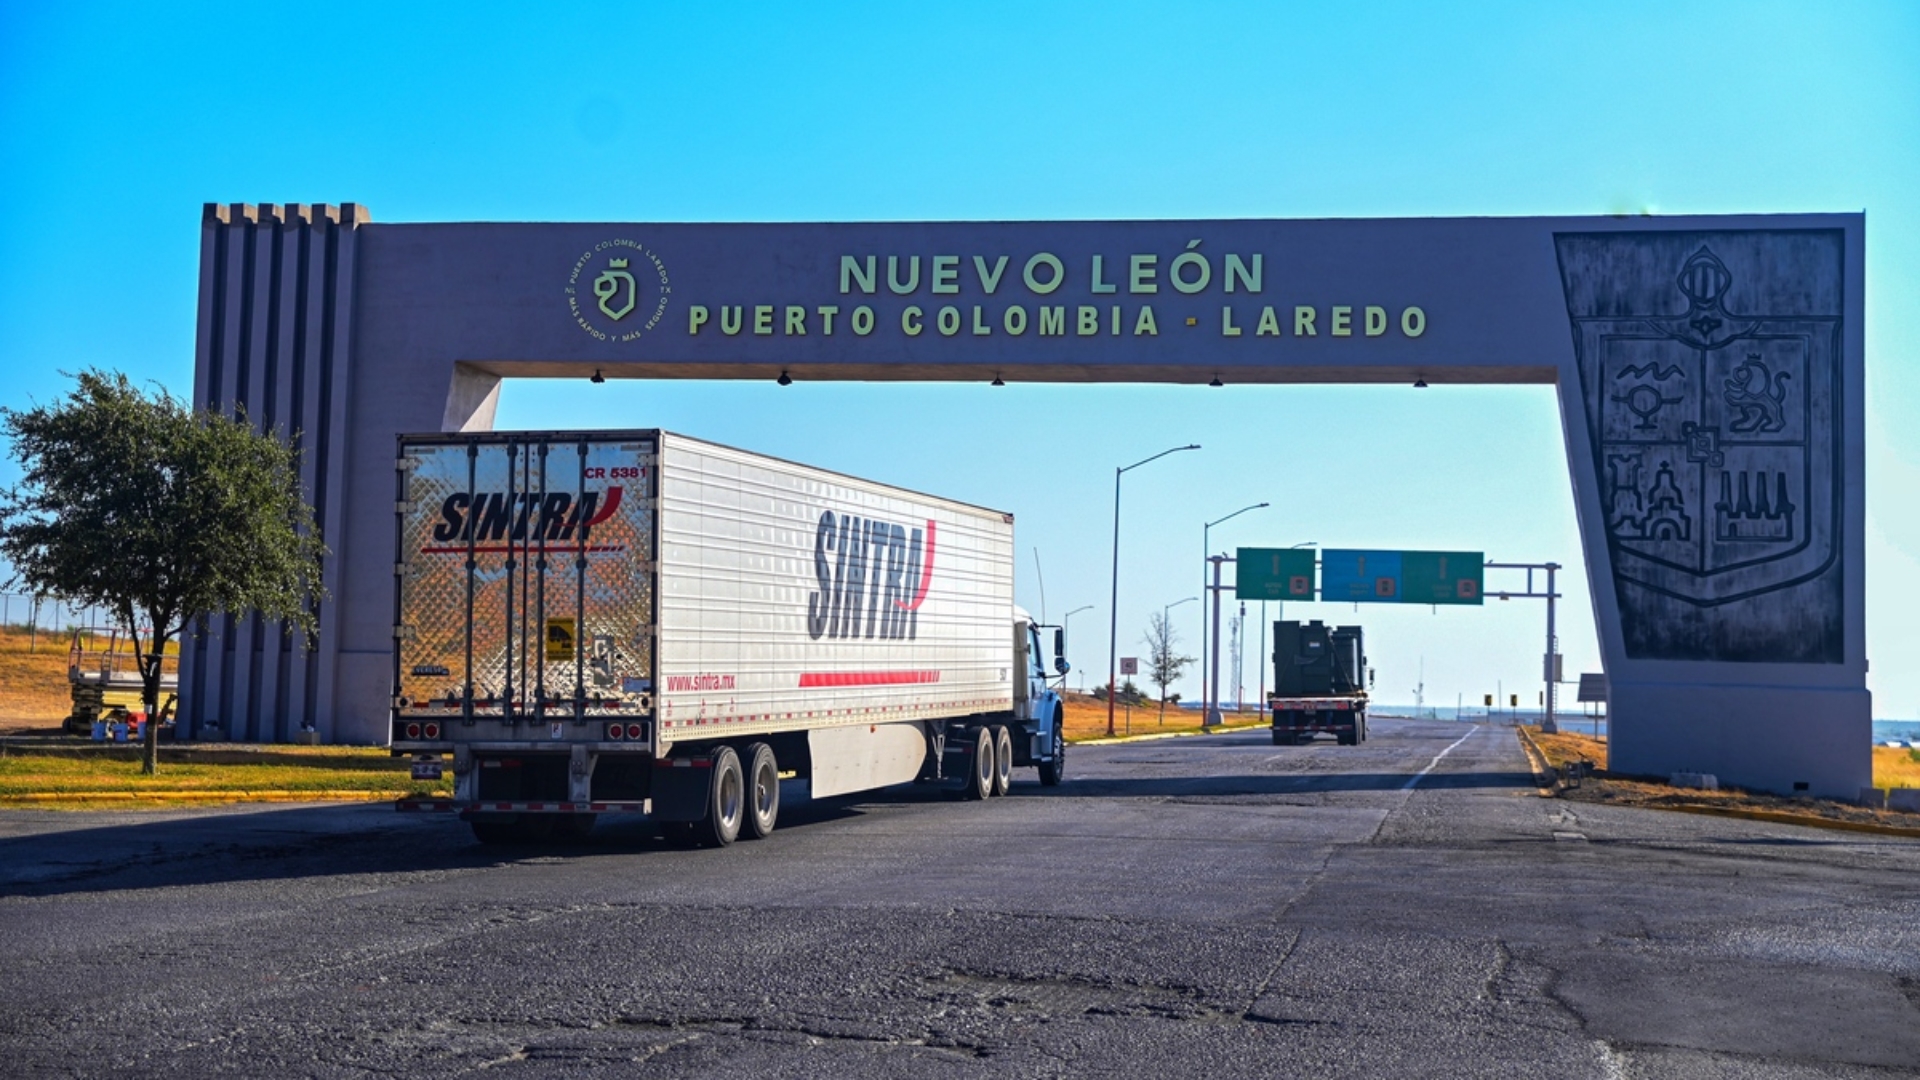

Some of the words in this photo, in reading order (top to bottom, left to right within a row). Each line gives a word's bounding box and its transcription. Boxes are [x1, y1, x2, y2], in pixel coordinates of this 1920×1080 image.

[569, 251, 592, 284] PUERTO
[595, 238, 643, 252] COLOMBIA
[645, 249, 669, 284] LAREDO
[839, 252, 1065, 295] NUEVO
[1091, 239, 1263, 294] LEÓN
[645, 297, 668, 331] SEGURO
[689, 305, 876, 337] PUERTO
[902, 305, 1159, 337] COLOMBIA
[1222, 306, 1427, 338] LAREDO
[584, 467, 605, 479] CR
[610, 467, 647, 479] 5381
[433, 486, 623, 542] SINTRA
[807, 509, 936, 641] SINTRA
[666, 673, 736, 692] www.sintra.mx
